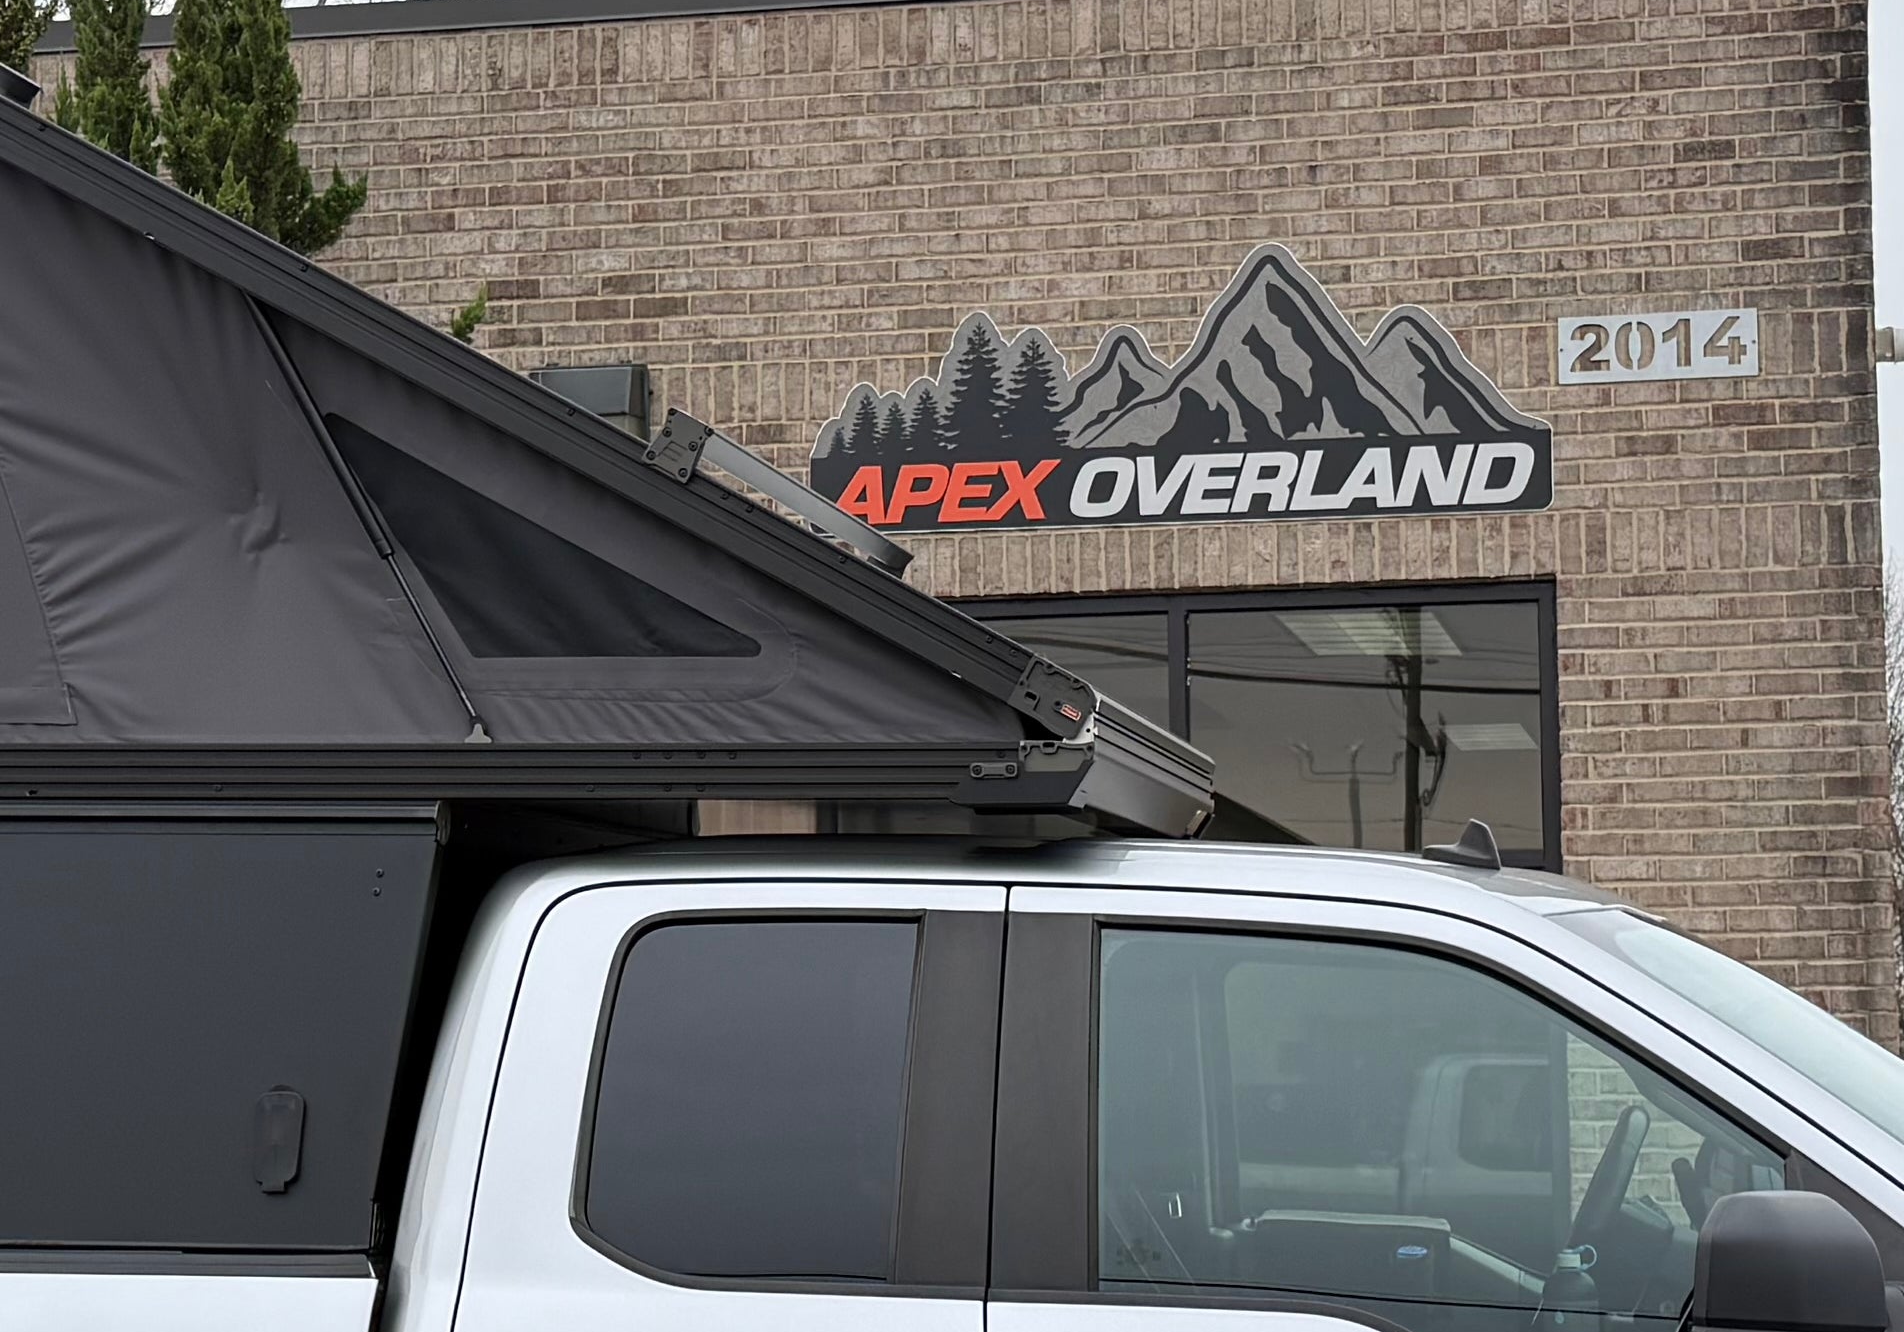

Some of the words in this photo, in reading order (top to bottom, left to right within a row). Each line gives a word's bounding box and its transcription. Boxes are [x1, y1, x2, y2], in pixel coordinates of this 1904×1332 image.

[1570, 315, 1747, 373] 2014
[836, 458, 1062, 524] APEX
[1069, 442, 1535, 517] OVERLAND
